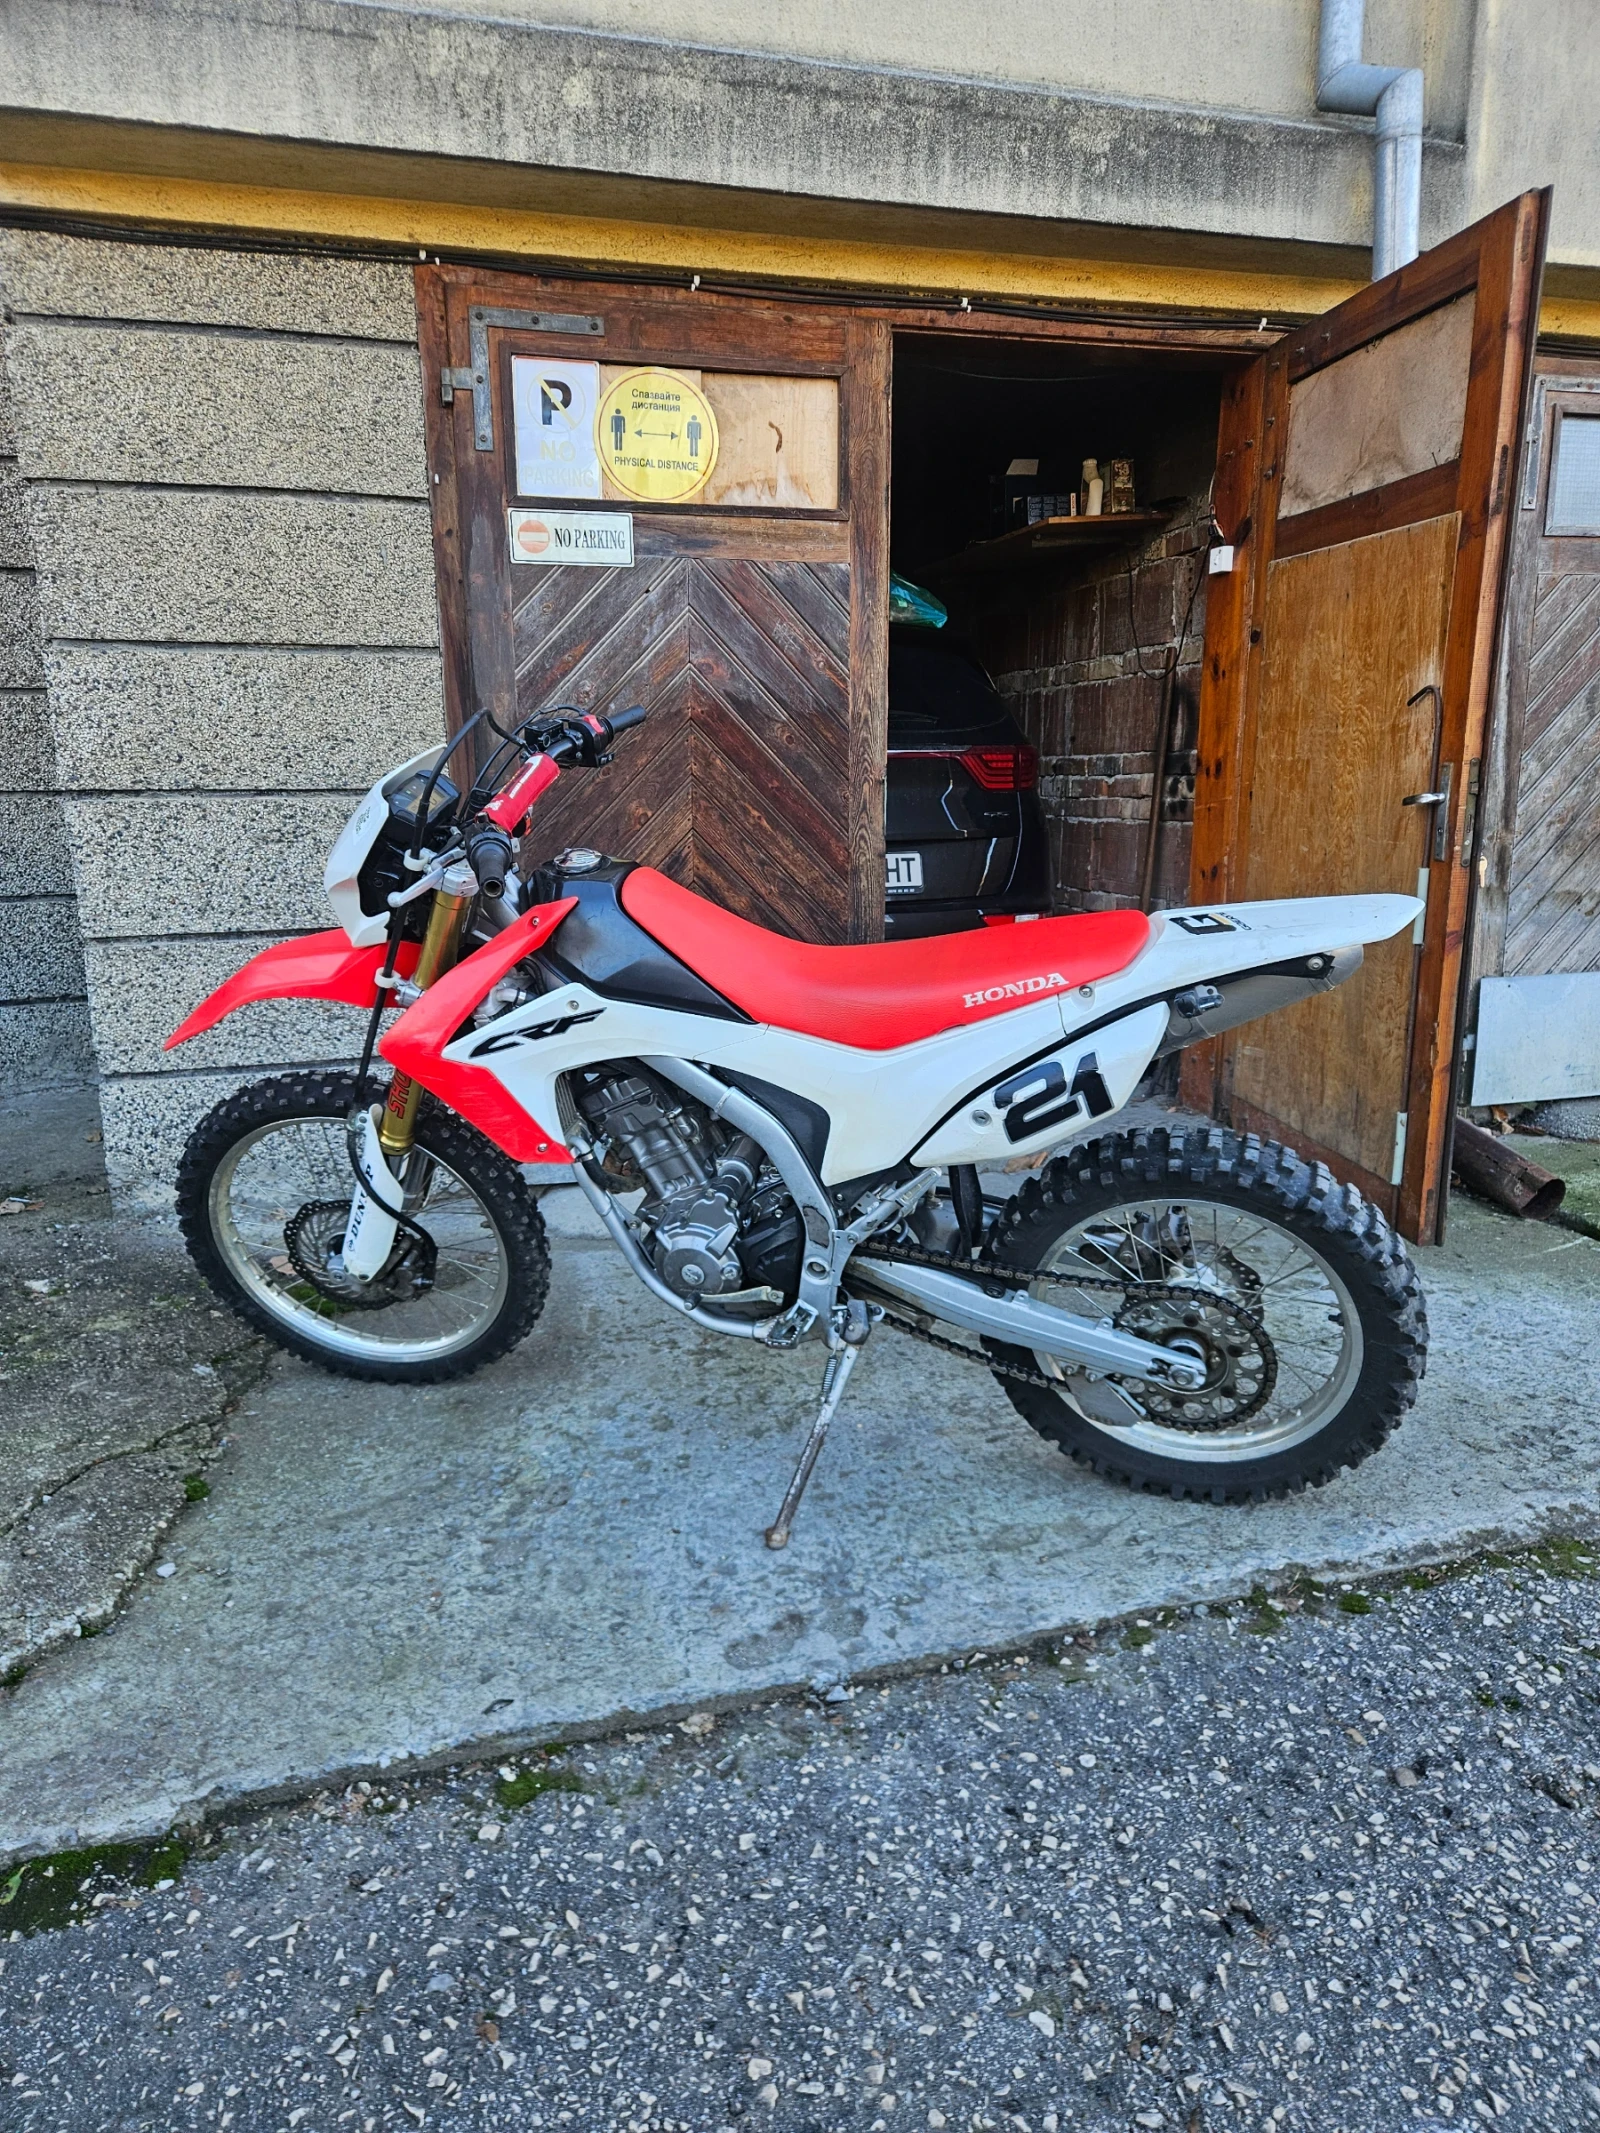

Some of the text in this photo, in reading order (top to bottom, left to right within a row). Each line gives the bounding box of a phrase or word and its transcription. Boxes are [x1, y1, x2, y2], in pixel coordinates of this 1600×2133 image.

[631, 388, 681, 402] Спазвайте
[631, 401, 681, 413] дистанция
[540, 440, 577, 463] NO
[614, 456, 699, 472] PHYSICAL DISTANCE
[524, 465, 594, 488] PARKING
[554, 528, 625, 550] NO PARKING
[963, 973, 1069, 1009] HONDA
[469, 1007, 608, 1059] CRF
[993, 1050, 1115, 1144] 21
